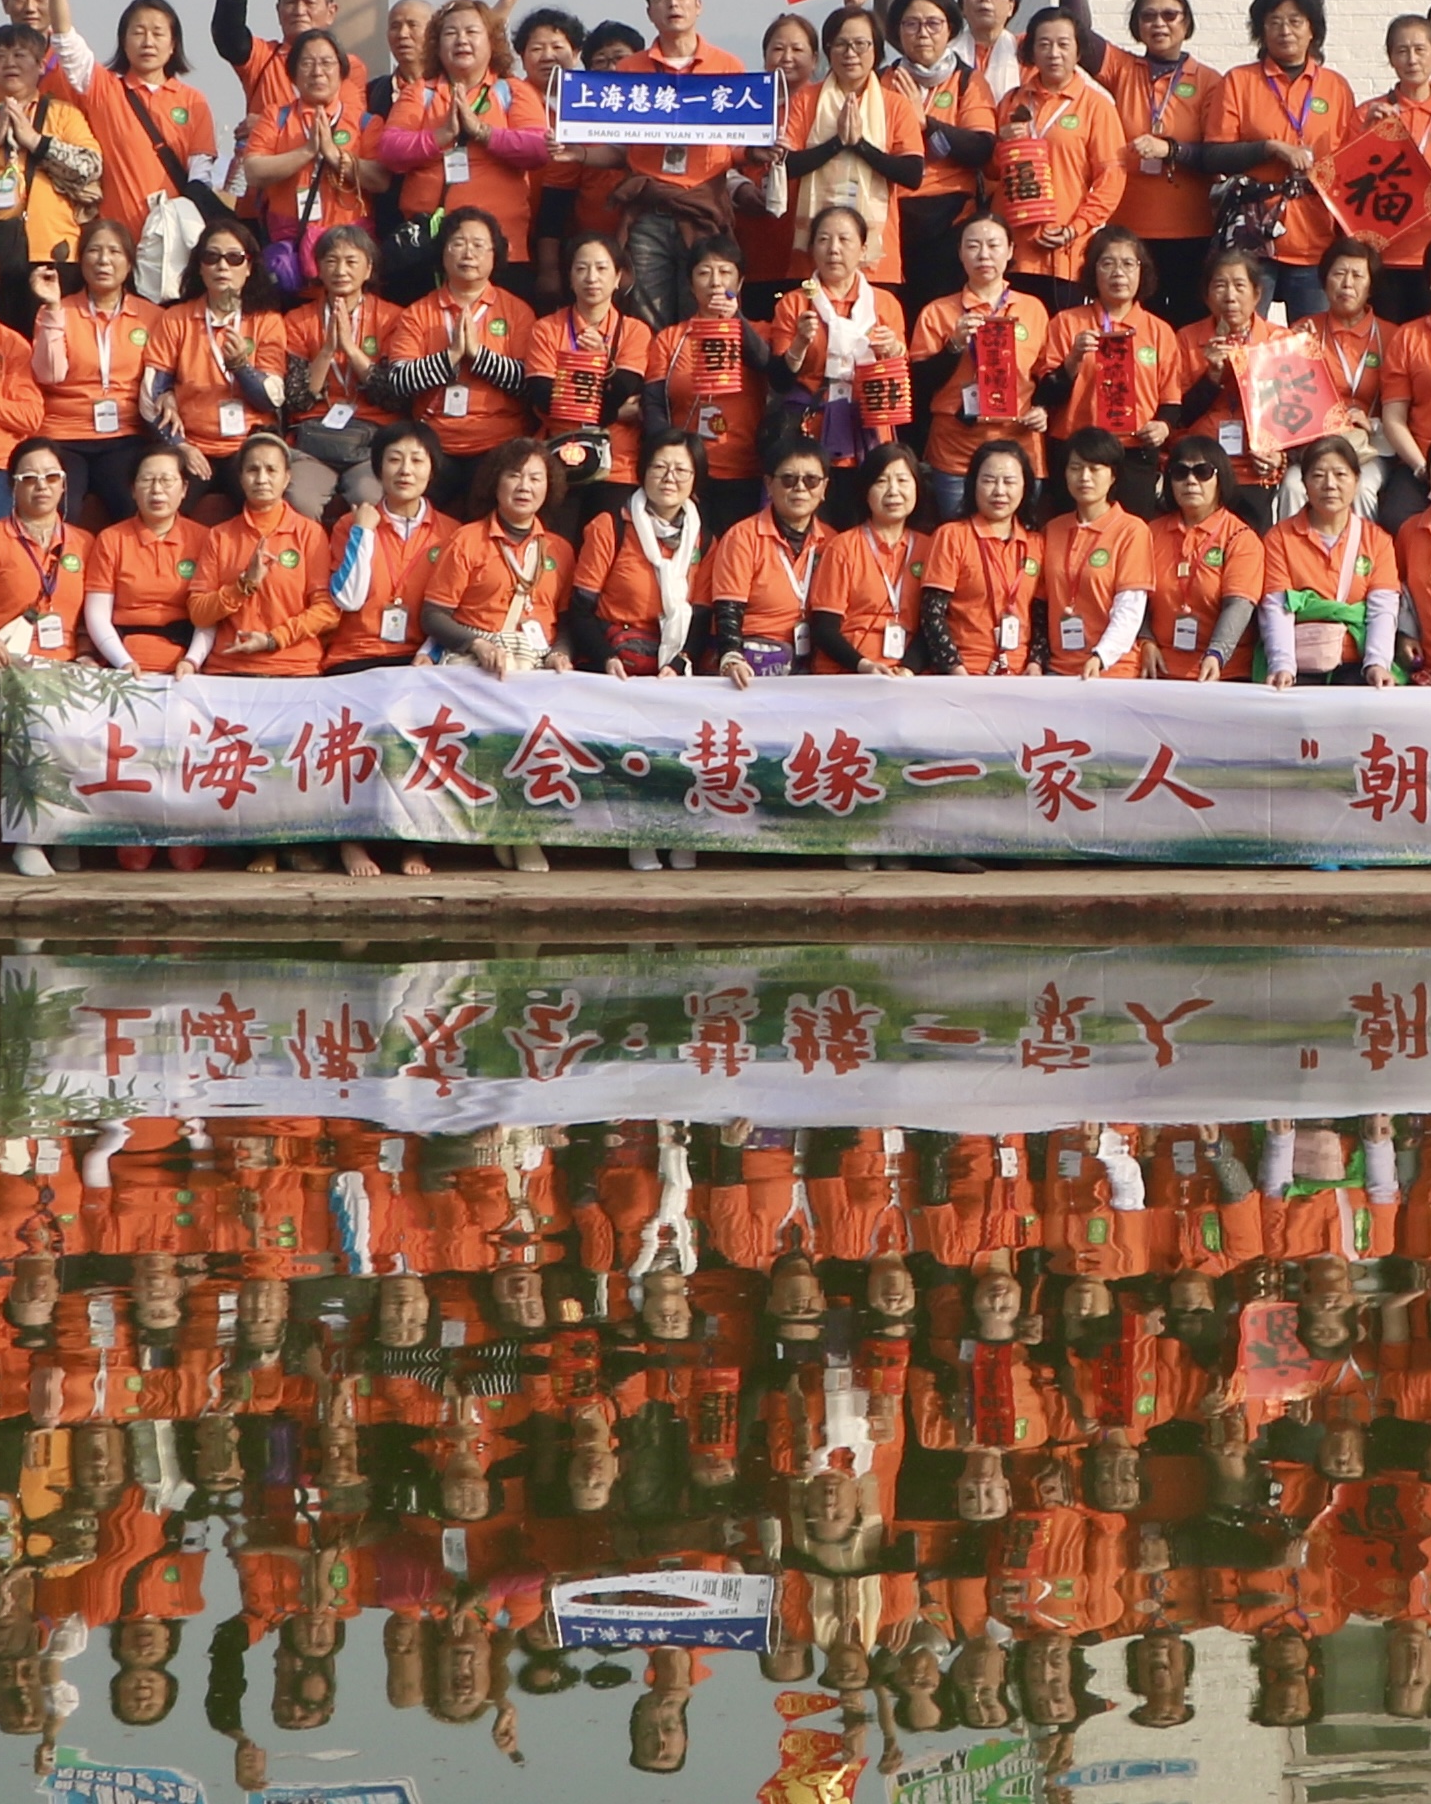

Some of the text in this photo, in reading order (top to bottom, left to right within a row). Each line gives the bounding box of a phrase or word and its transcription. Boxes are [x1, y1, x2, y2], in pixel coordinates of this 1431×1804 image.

[571, 82, 763, 114] 上海慧缘一家人
[587, 129, 746, 140] SHANG HAI HUI YUAN YI JIA REN
[1344, 149, 1413, 226] 福
